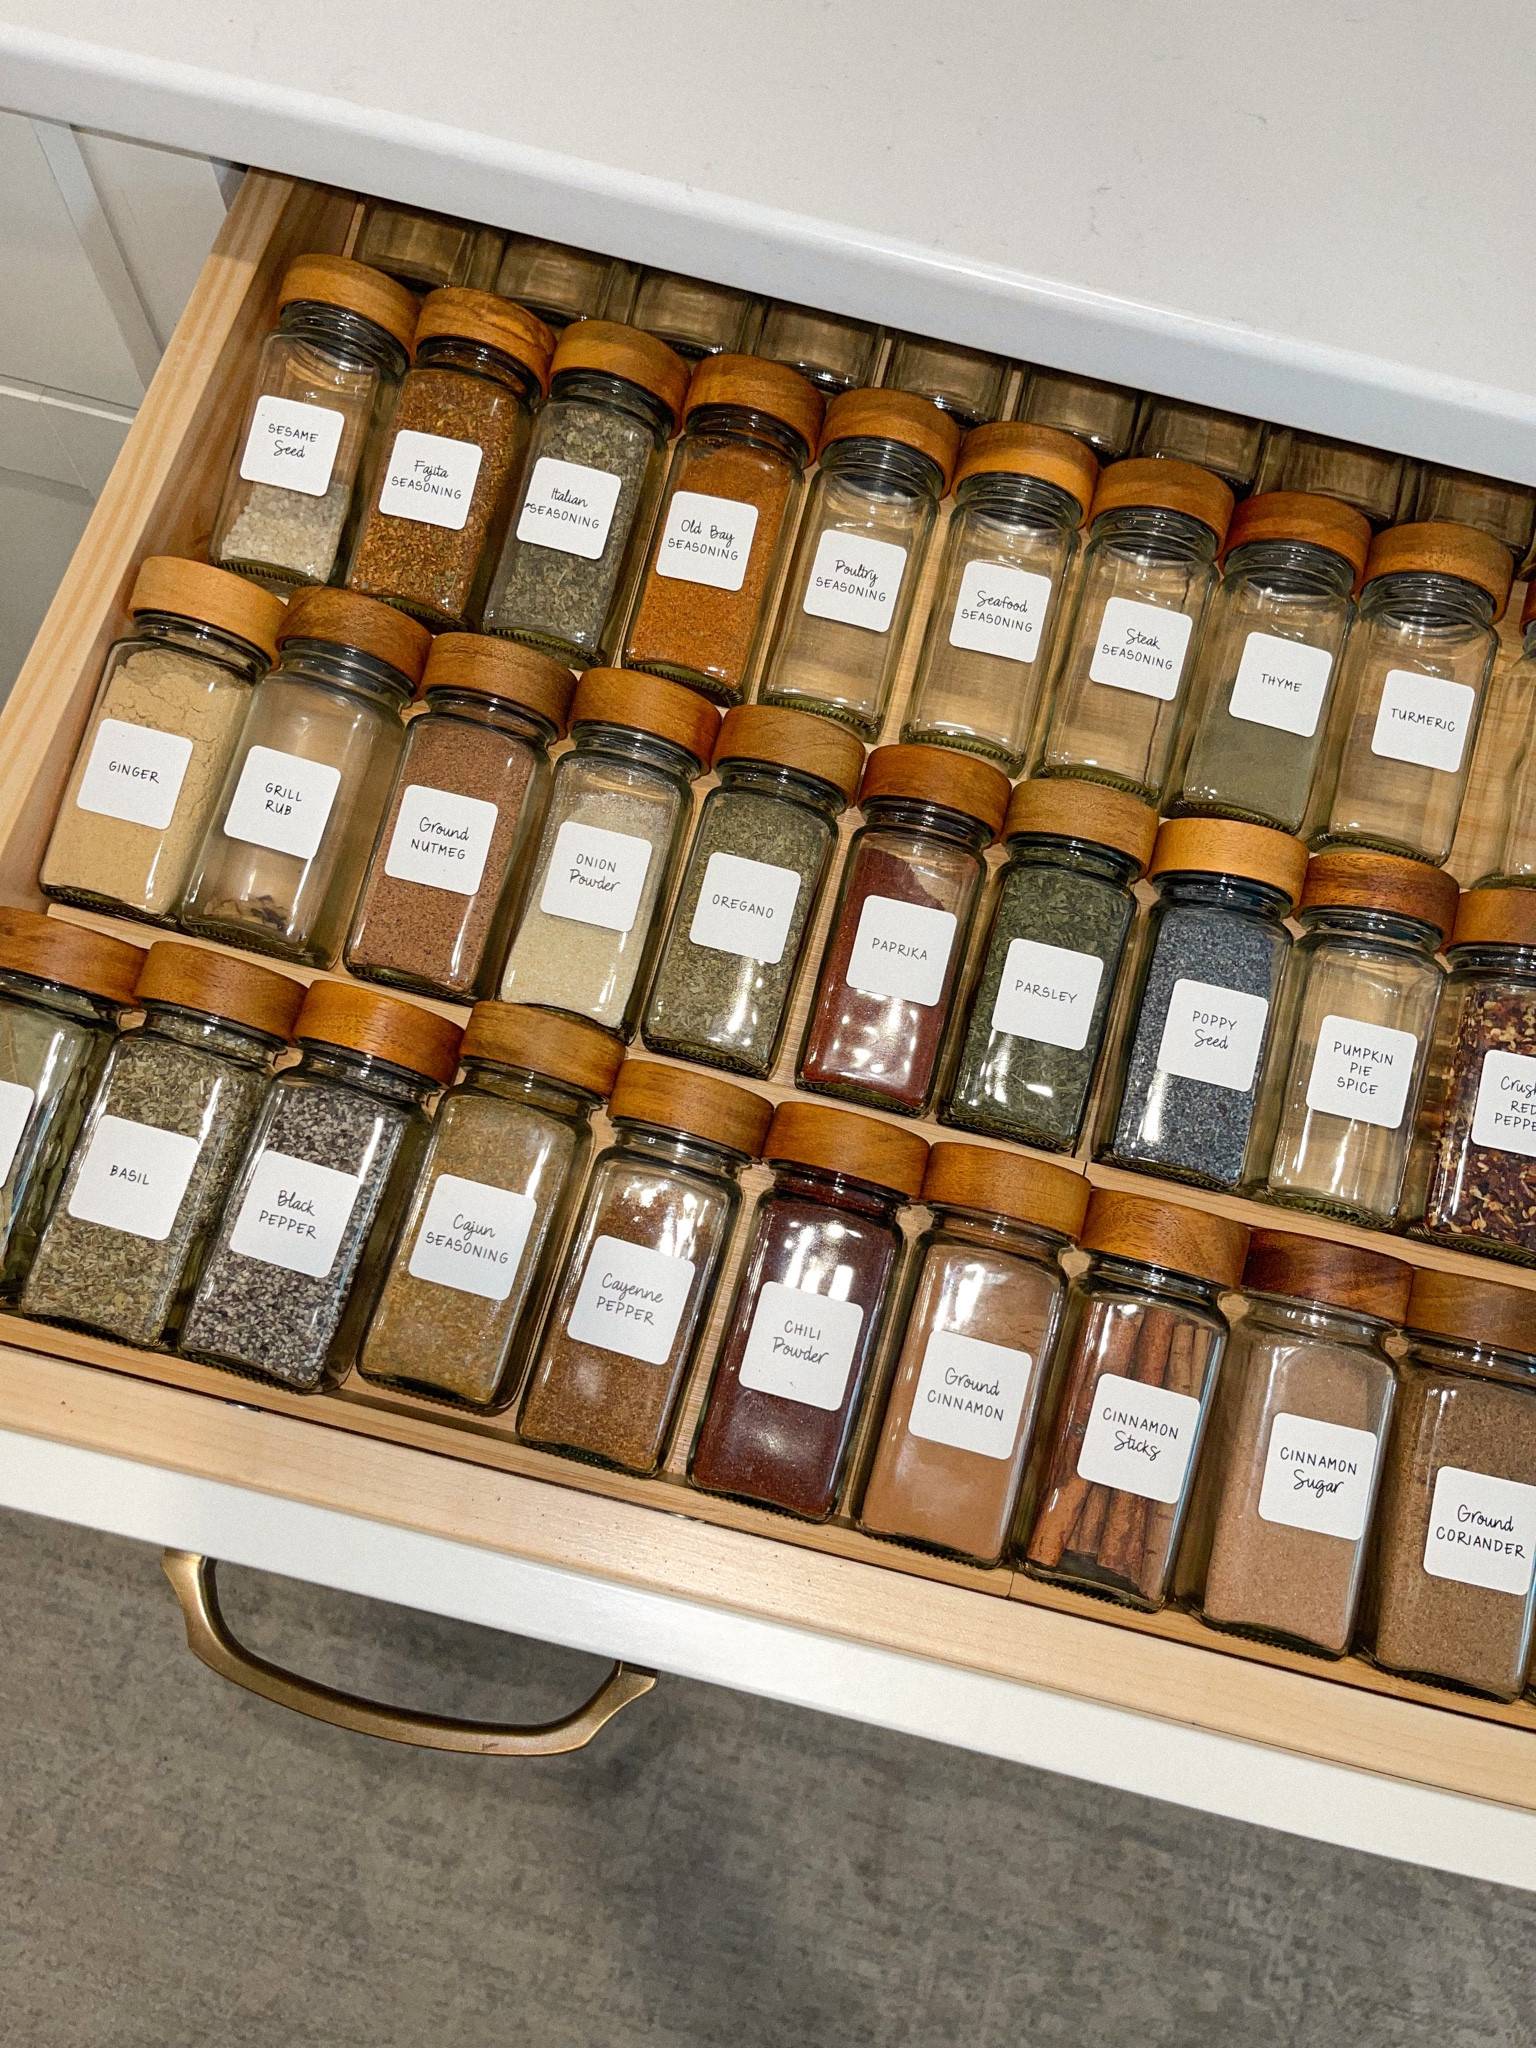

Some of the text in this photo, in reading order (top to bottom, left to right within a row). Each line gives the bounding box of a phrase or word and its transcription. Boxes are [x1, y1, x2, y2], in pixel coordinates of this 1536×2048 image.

[267, 422, 319, 443] SESAME
[273, 439, 306, 459] Seed
[413, 459, 449, 483] Fajita
[391, 475, 462, 500] SEASONING
[550, 487, 588, 508] Italian
[528, 503, 600, 529] SEASONING
[680, 519, 735, 549] Old Bay
[667, 537, 739, 561] SEASONING
[834, 559, 879, 588] Poultry
[815, 576, 887, 602] SEASONING
[976, 590, 1028, 613] Seafood
[960, 608, 1033, 633] SEASONING
[1125, 627, 1161, 650] Steak
[1101, 643, 1173, 670] SEASONING
[1261, 673, 1303, 693] THYME
[1391, 707, 1456, 732] TURMERIC
[108, 760, 160, 784] GINGER
[265, 782, 302, 800] GRILL
[264, 799, 292, 816] RUB
[419, 816, 470, 841] Ground
[410, 838, 466, 860] NUTMEG
[576, 853, 617, 873] ONION
[569, 868, 621, 892] Powder
[712, 893, 774, 919] OREGANO
[871, 937, 927, 961] PAPRIKA
[1015, 979, 1078, 1004] PARSLEY
[1192, 1010, 1238, 1031] POPPY
[1194, 1028, 1229, 1050] Seed
[1333, 1040, 1394, 1066] PUMPKIN
[1349, 1061, 1373, 1077] PIE
[1336, 1076, 1379, 1095] SPICE
[1500, 1075, 1536, 1099] Crus
[109, 1164, 150, 1186] BASIL
[277, 1189, 316, 1217] Black
[258, 1209, 317, 1240] PEPPER
[452, 1213, 496, 1241] Cajun
[425, 1231, 509, 1265] SEASONING
[601, 1272, 664, 1304] Cayenne
[596, 1295, 654, 1326] PEPPER
[784, 1320, 821, 1341] CHILI
[772, 1336, 830, 1365] Powder
[944, 1366, 1000, 1397] Ground
[927, 1389, 1004, 1422] CINNAMON
[1102, 1407, 1179, 1440] CINNAMON
[1113, 1430, 1162, 1462] Sticks
[1279, 1446, 1358, 1476] CINNAMON
[1293, 1468, 1345, 1499] Sugar
[1457, 1503, 1515, 1533] Ground
[1435, 1526, 1526, 1560] CORIANDER
